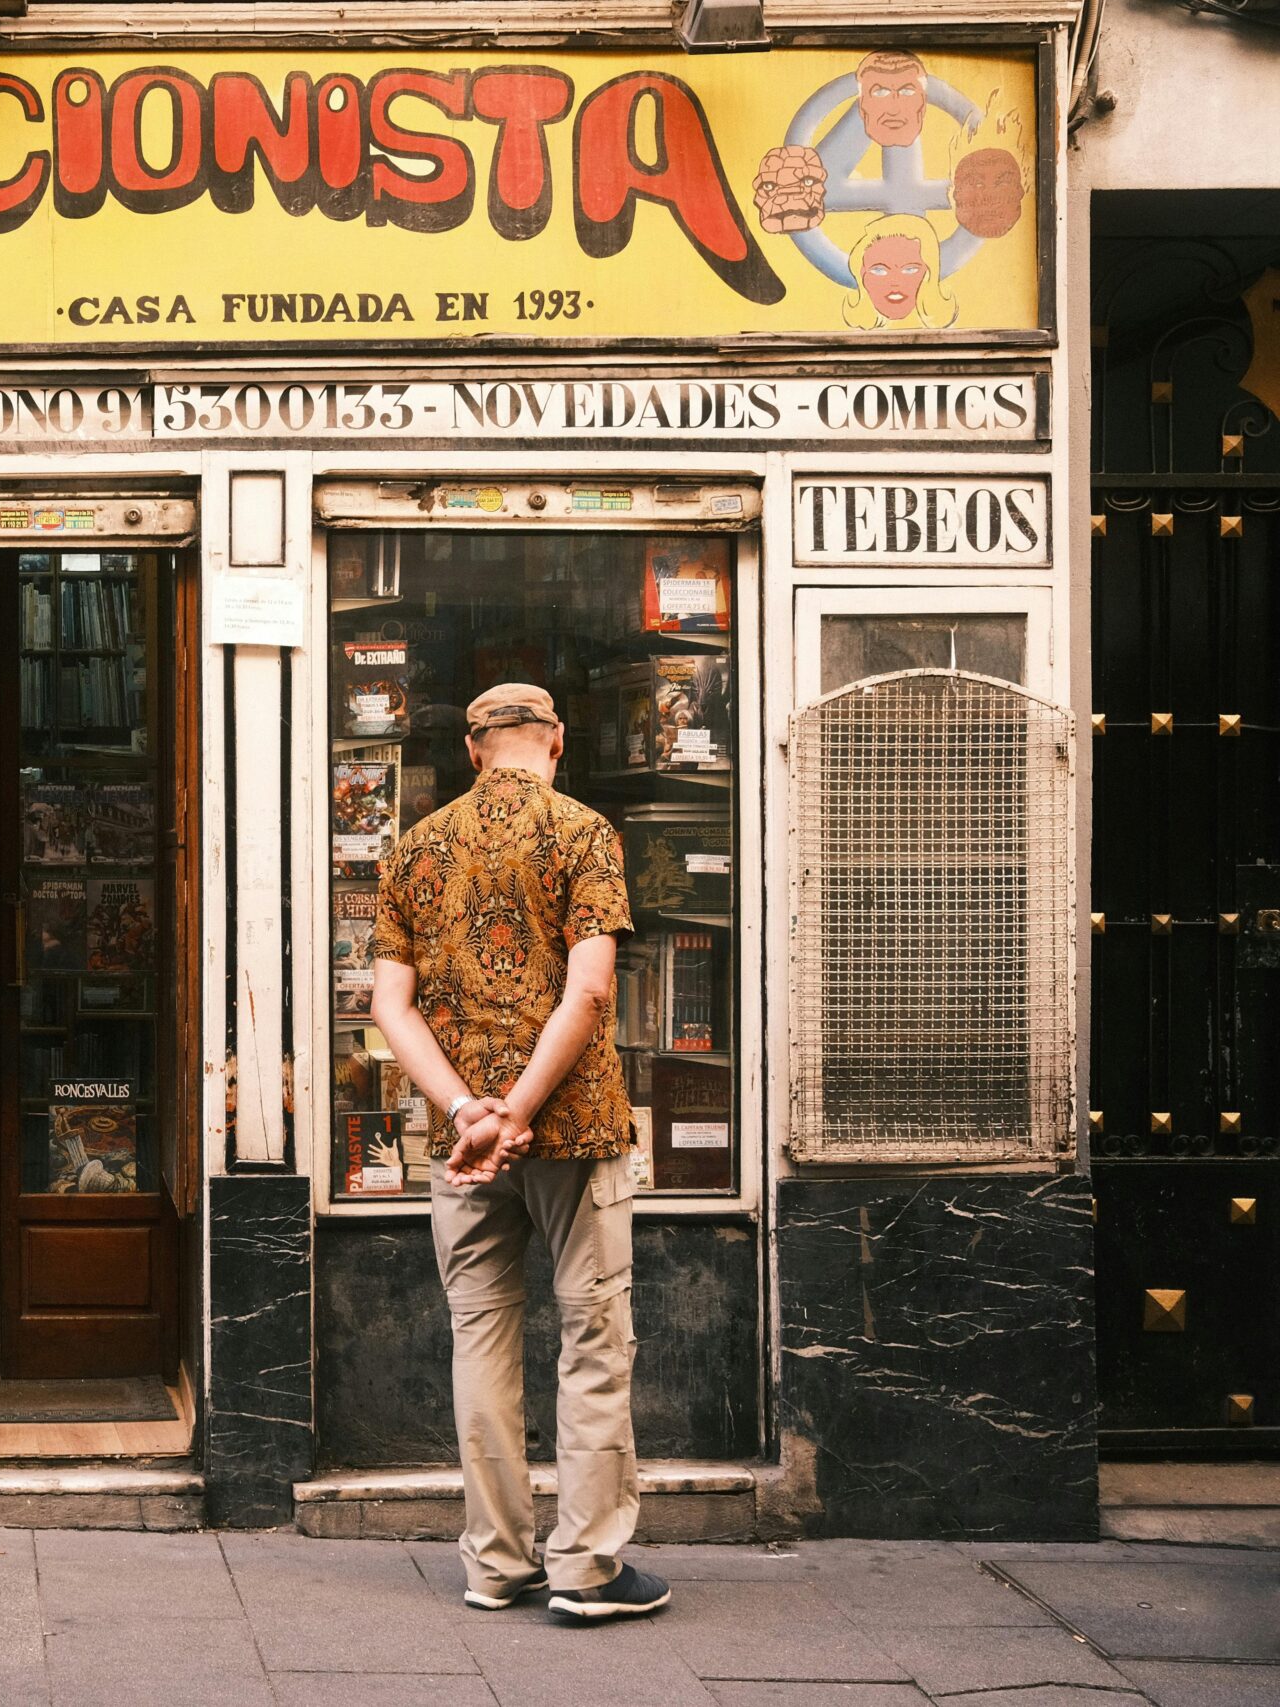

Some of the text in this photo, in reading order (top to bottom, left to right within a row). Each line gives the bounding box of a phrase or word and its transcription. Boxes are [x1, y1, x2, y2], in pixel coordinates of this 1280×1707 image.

[222, 294, 413, 322] FUNDADA
[436, 293, 489, 321] EN
[451, 382, 781, 430] NOVEDADES
[817, 384, 1027, 430] COMICS
[800, 486, 1038, 554] TEBEOS
[367, 649, 406, 665] EXTRAÑO
[102, 884, 138, 894] MARVEL
[54, 1083, 130, 1099] RONCESVALLES
[398, 1099, 417, 1107] PIEL
[384, 1115, 392, 1132] 1
[348, 1116, 363, 1192] PARASYTE
